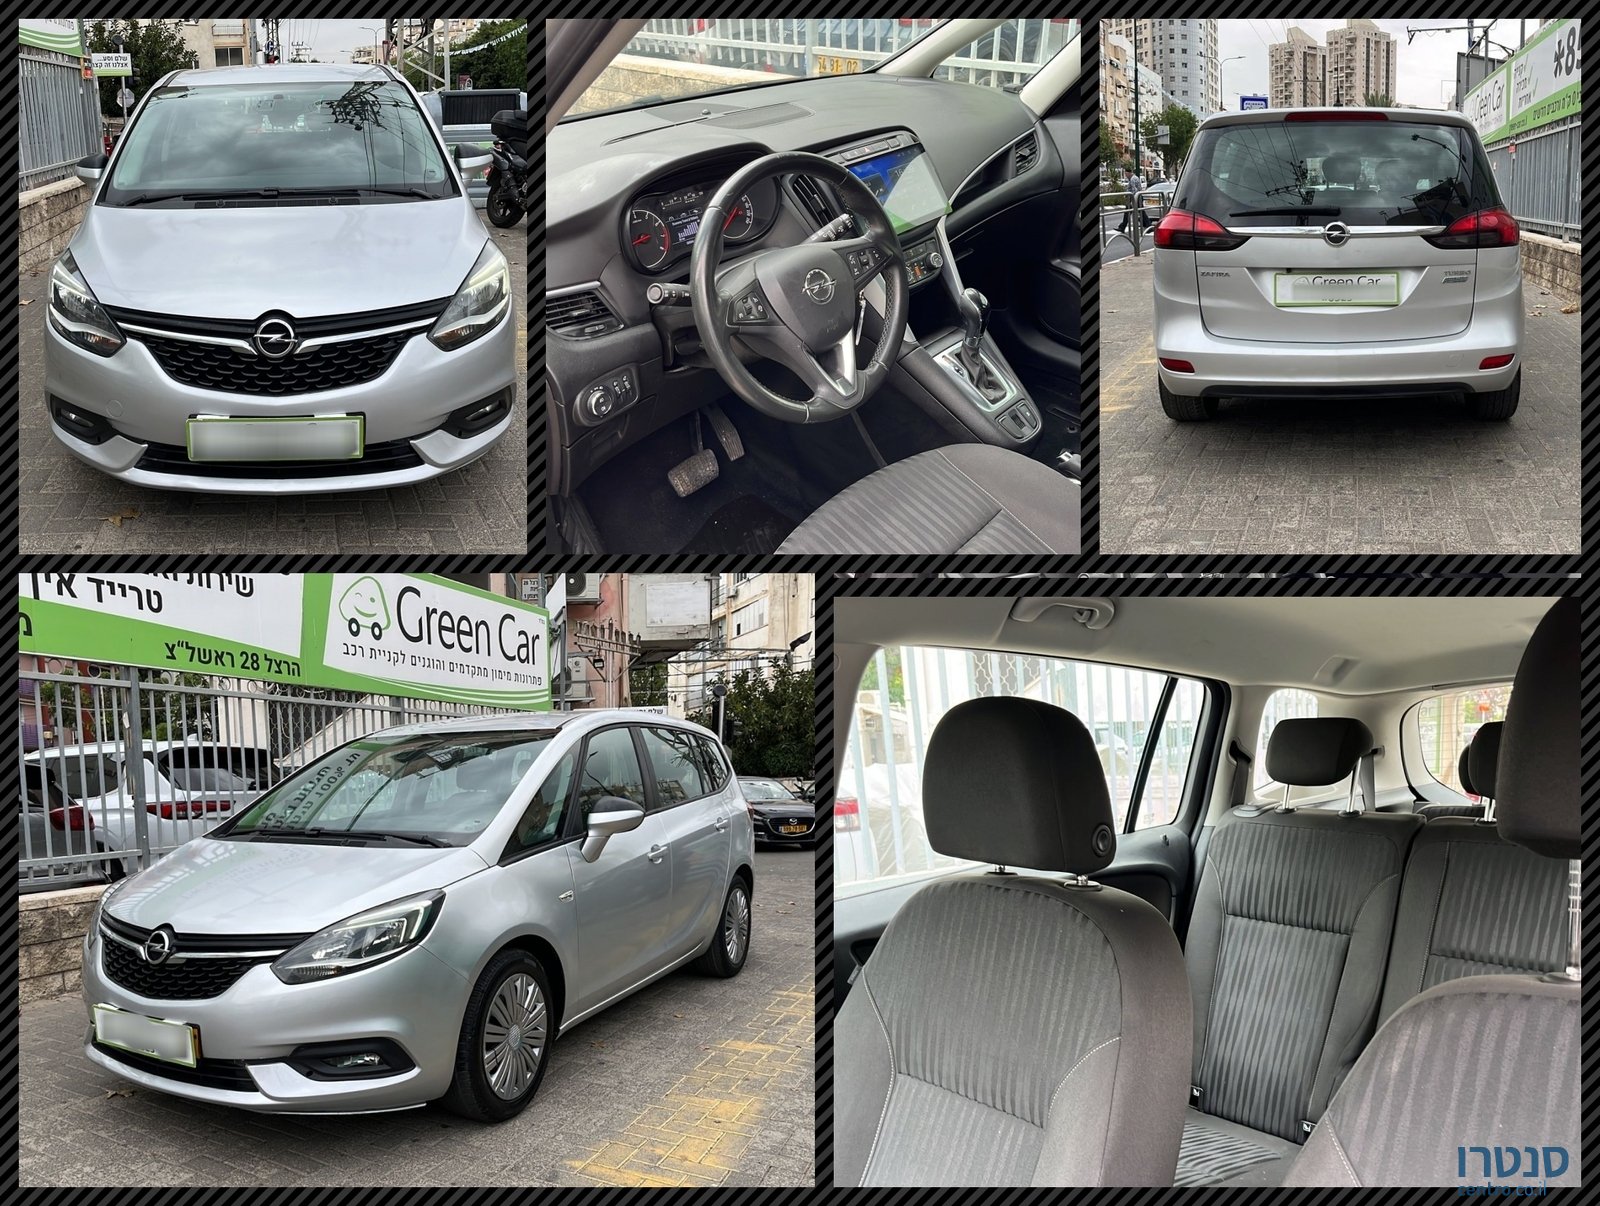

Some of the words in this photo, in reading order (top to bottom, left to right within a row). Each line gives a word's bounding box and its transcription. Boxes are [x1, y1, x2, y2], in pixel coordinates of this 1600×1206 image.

[87, 576, 163, 613] טרייד
[396, 585, 491, 657] Green
[499, 613, 540, 665] Car
[342, 642, 365, 656] רכב
[369, 646, 406, 666] לקניית
[239, 650, 260, 672] 28
[264, 653, 301, 677] הרצל
[410, 653, 445, 671] והוגנים
[449, 660, 489, 679] מתקדמים
[491, 668, 512, 682] מימון
[514, 671, 543, 686] פתרונות
